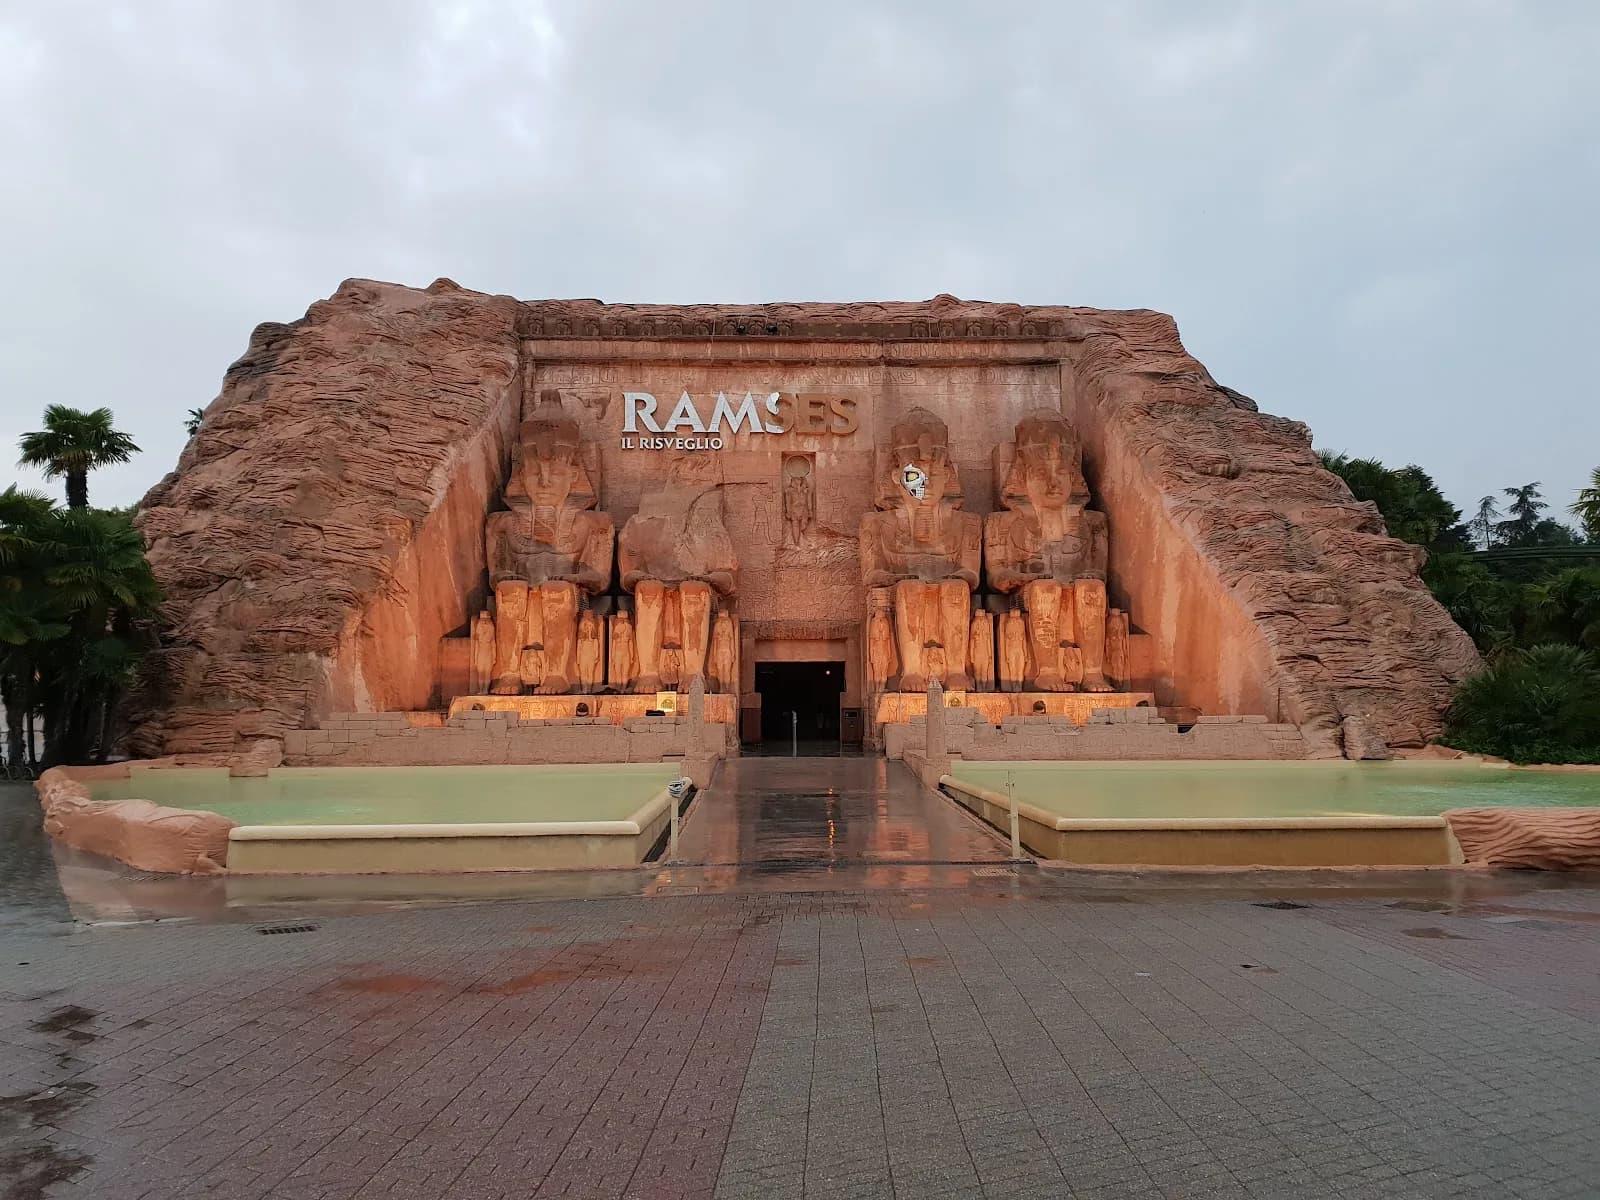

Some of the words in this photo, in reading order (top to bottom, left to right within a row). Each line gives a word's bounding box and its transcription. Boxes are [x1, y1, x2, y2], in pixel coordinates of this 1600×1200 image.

[622, 390, 857, 434] RAMSES
[621, 437, 635, 450] IL
[639, 437, 723, 450] RISVEGLIO
